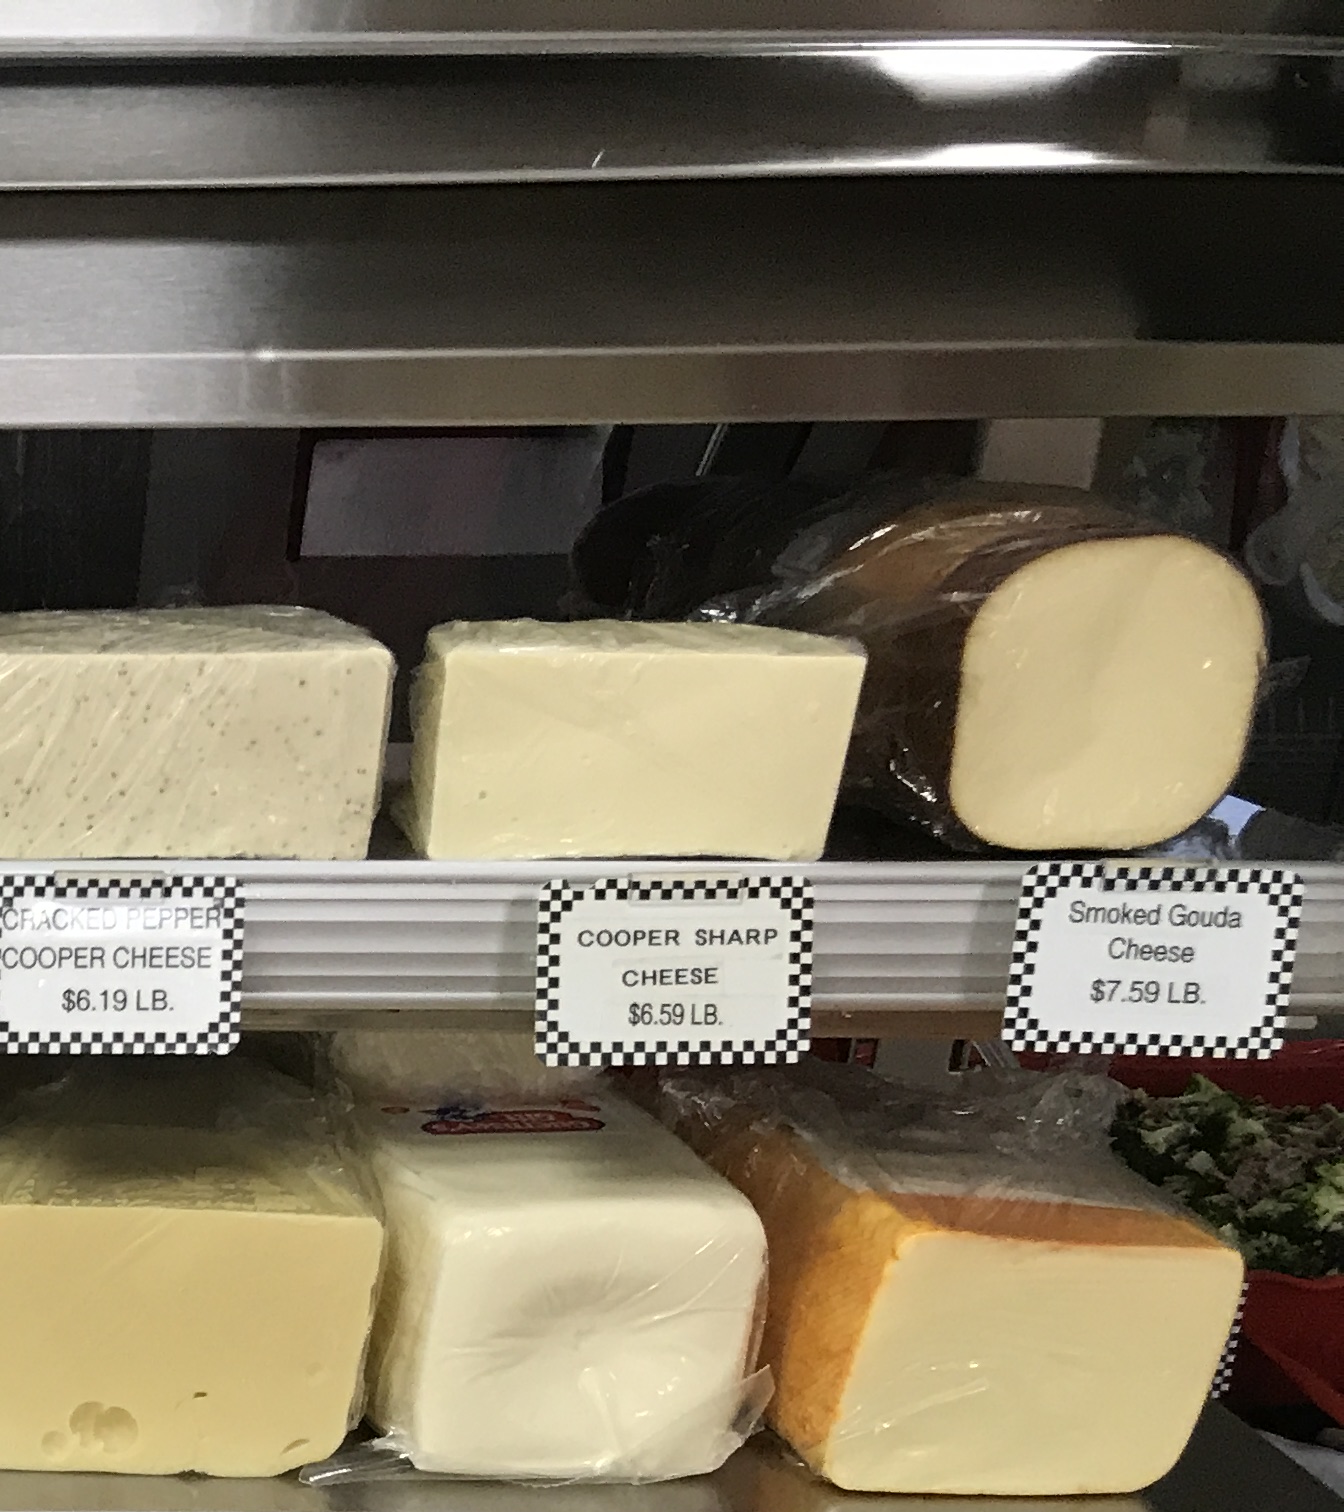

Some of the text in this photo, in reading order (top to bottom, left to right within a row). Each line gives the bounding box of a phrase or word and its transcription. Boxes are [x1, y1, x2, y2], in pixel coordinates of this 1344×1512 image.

[2, 907, 222, 931] CRACKED PEPPER
[1069, 900, 1242, 929] Smoked Gouda
[577, 928, 778, 947] COOPER SHARP
[1, 946, 212, 969] COOPER CHEESE
[1108, 937, 1195, 963] Cheese
[622, 967, 719, 987] CHEESE
[62, 988, 175, 1012] $6.19 LB.
[1090, 978, 1207, 1005] $7.59 LB.
[628, 1002, 724, 1027] $6.59 LB.
